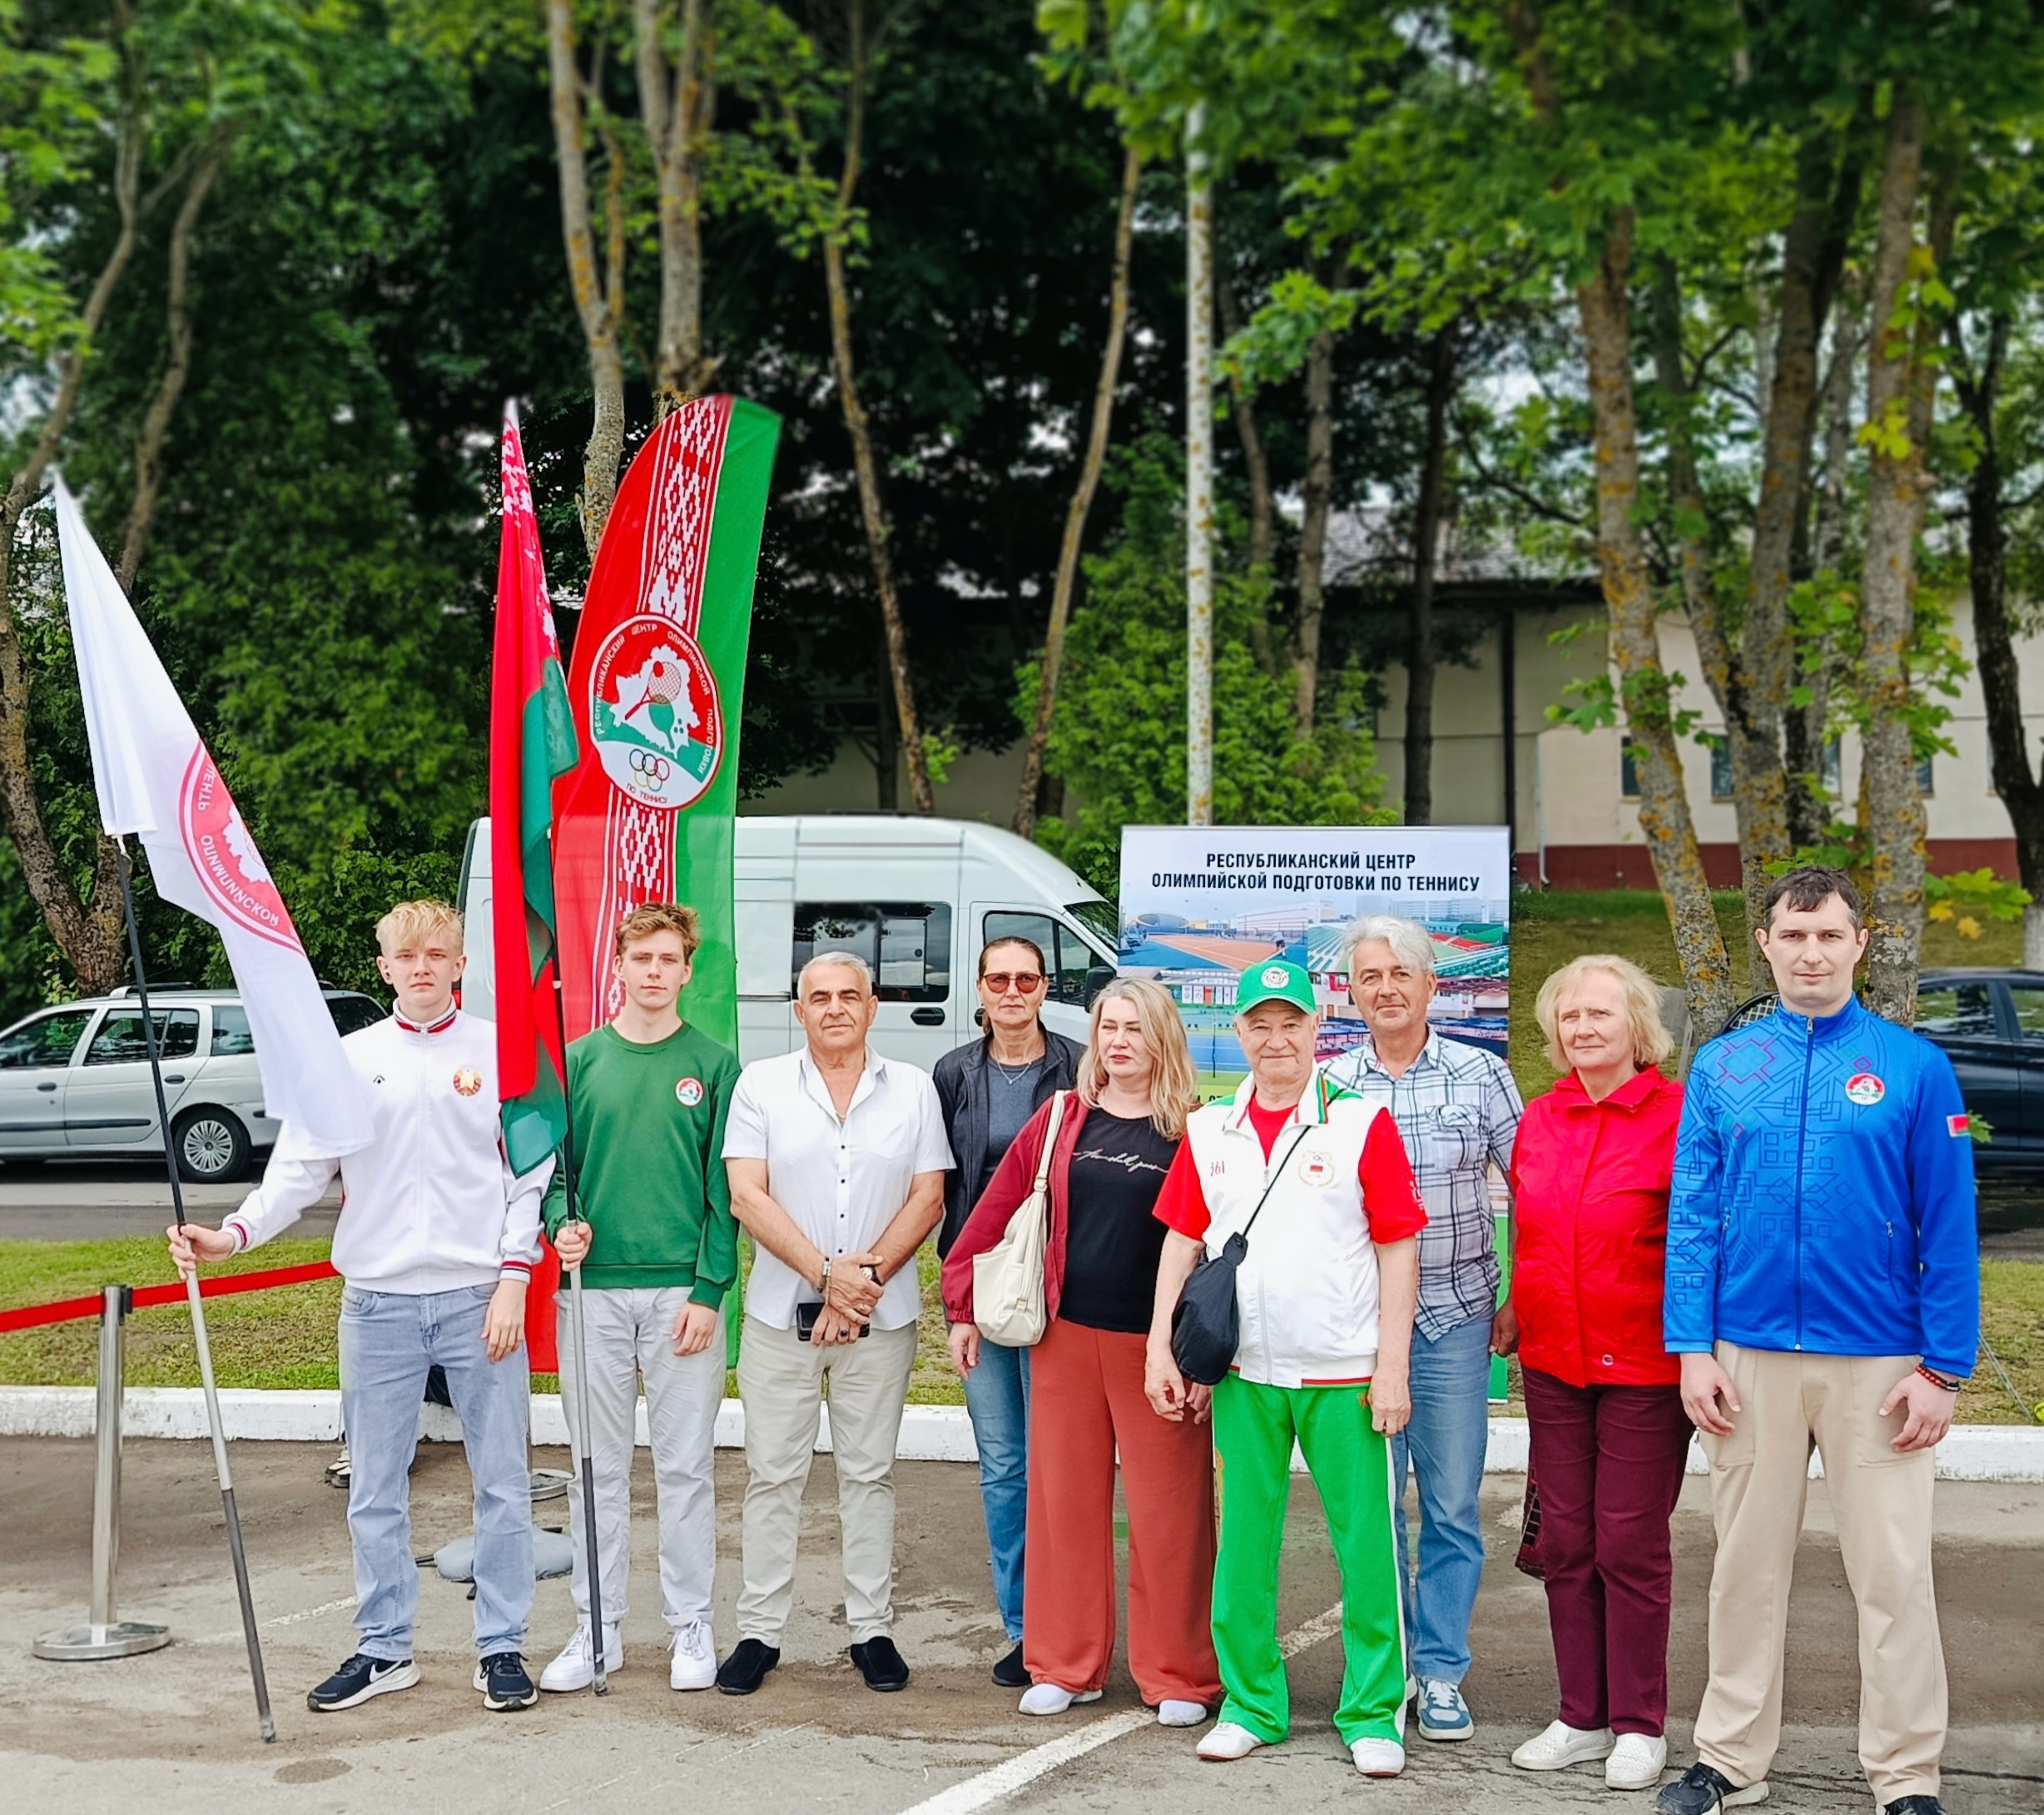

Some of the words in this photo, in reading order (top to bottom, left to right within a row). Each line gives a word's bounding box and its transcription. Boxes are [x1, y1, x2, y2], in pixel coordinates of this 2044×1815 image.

[594, 634, 626, 735] РЕСПУБЛИКАНСКИЙ
[631, 623, 657, 636] ЦЕНТР
[667, 630, 712, 696] ОЛИМПИЙСКОЙ
[697, 708, 714, 775] ПОДГОТОВКИ
[626, 782, 637, 794] ПО
[639, 791, 668, 805] ТЕННИСУ
[1206, 851, 1360, 869] РЕСПУБЛИКАНСКИЙ
[1366, 854, 1416, 871] ЦЕНТР
[1152, 871, 1267, 889] ОЛИМПИЙСКОЙ
[1273, 875, 1376, 892] ПОДГОТОВКИ
[1381, 875, 1402, 891] ПО
[1407, 875, 1480, 891] ТЕННИСУ
